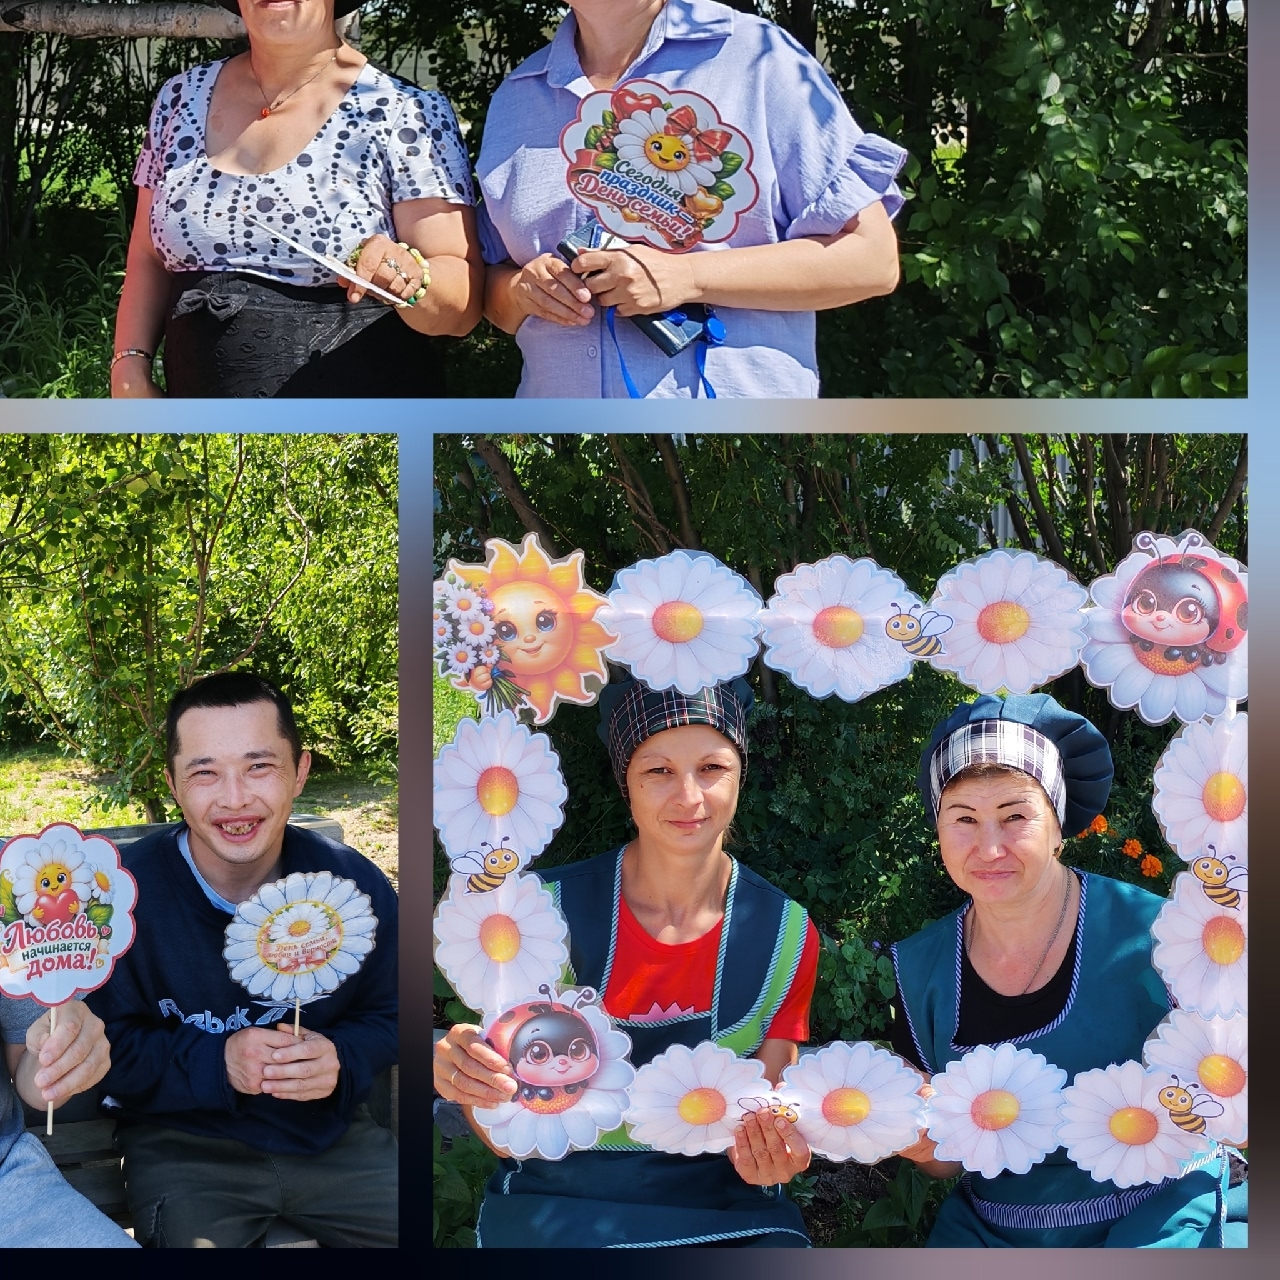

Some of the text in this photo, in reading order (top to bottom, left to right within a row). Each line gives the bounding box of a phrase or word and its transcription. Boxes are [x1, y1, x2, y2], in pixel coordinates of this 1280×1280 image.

[600, 170, 677, 214] праздник
[615, 160, 683, 200] Сегодня
[578, 174, 694, 240] День семьи!
[2, 913, 98, 954] Любовь
[21, 941, 91, 961] начинается
[27, 948, 96, 980] дома!
